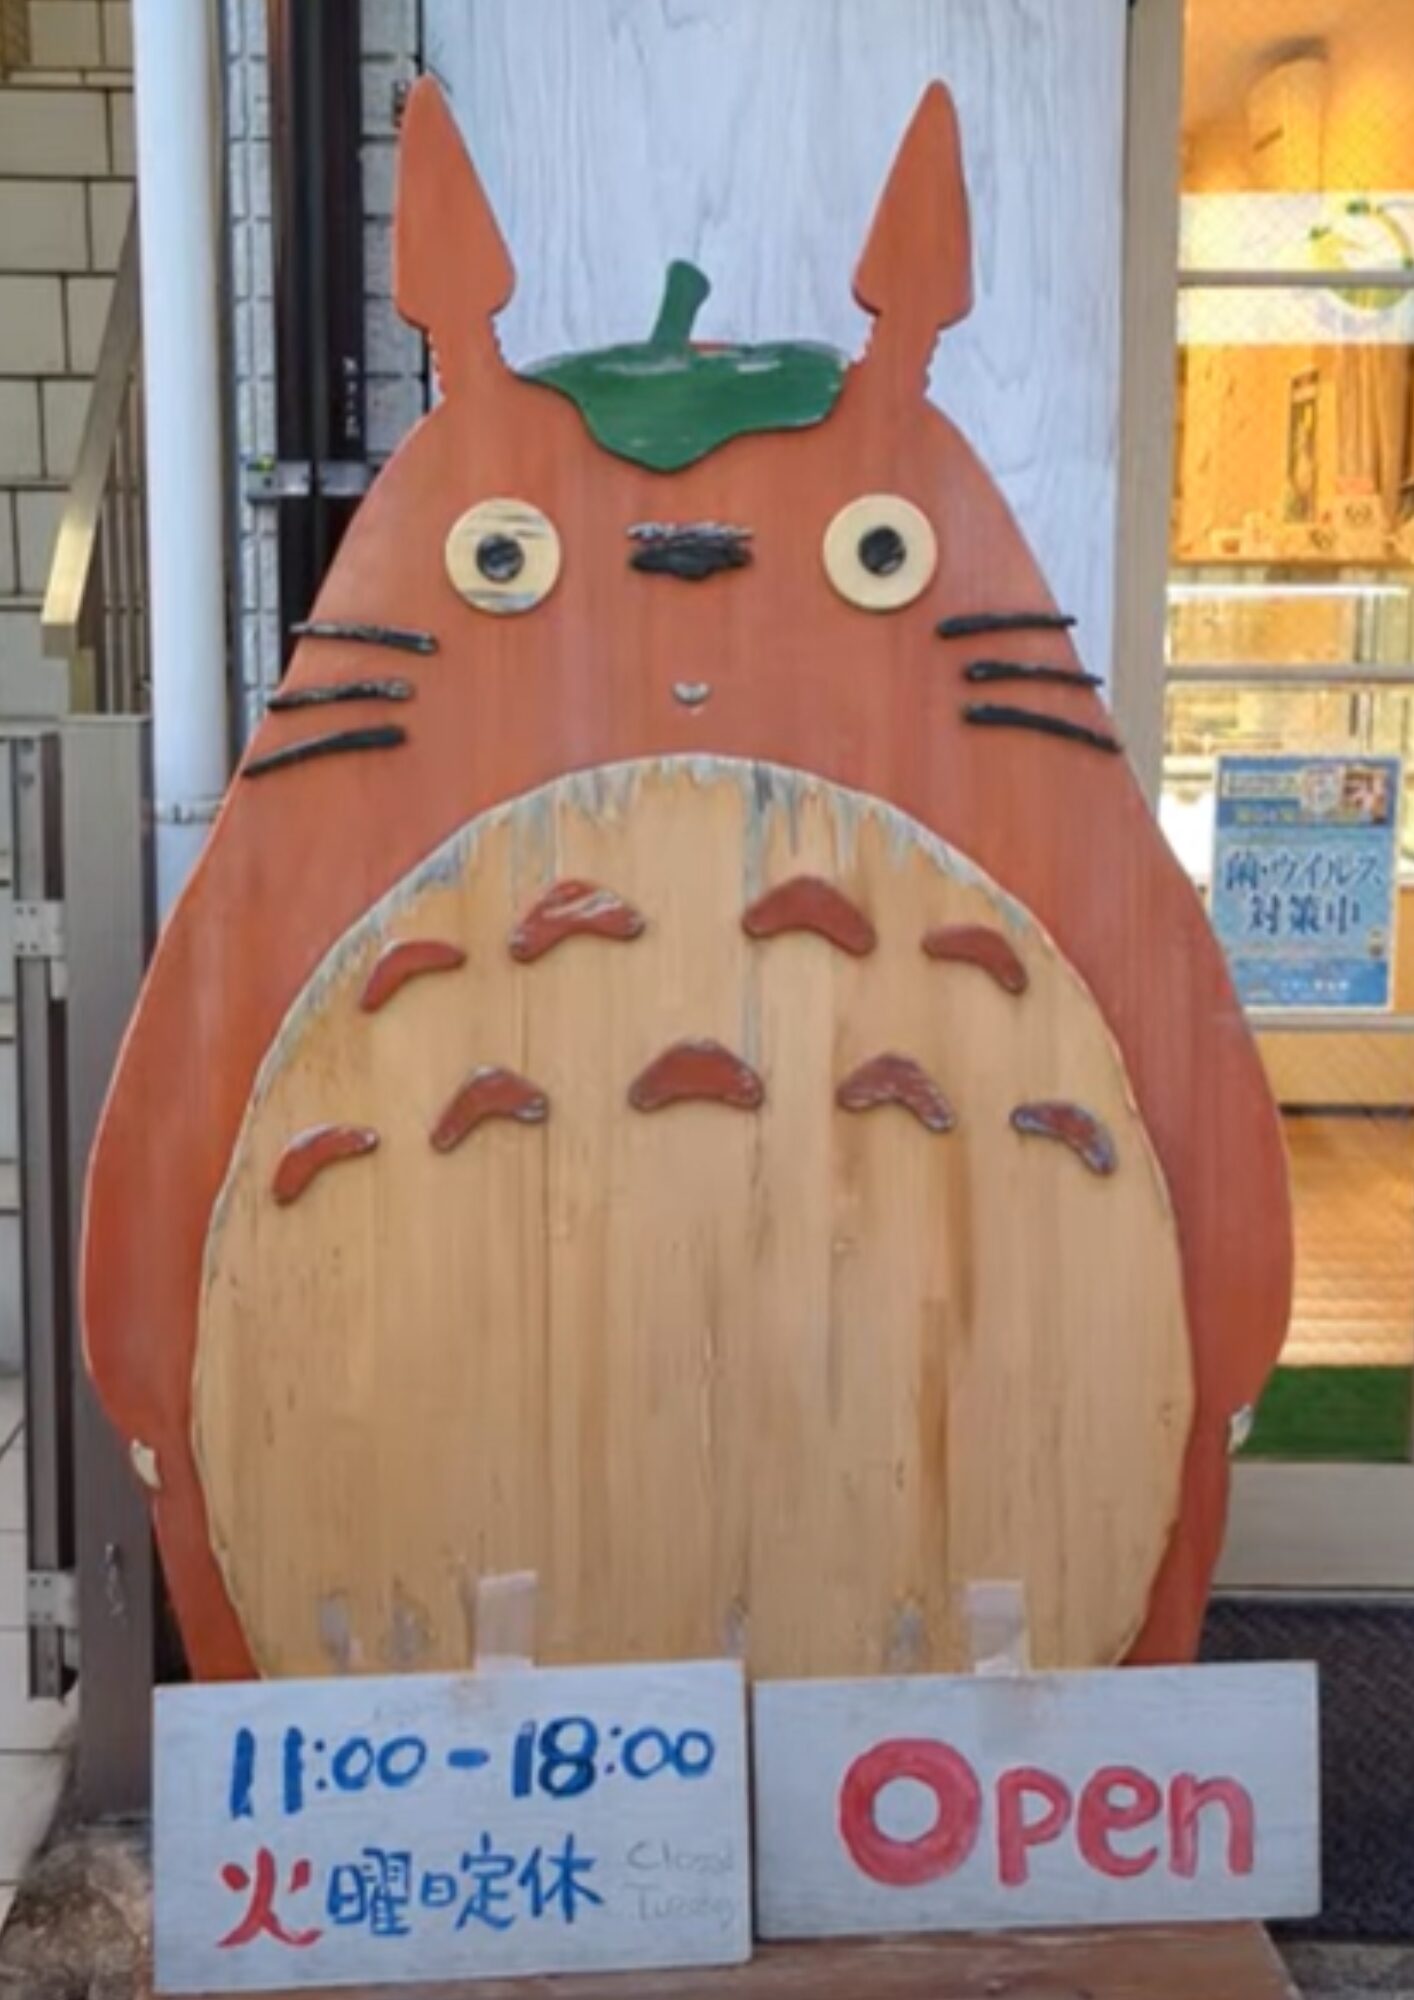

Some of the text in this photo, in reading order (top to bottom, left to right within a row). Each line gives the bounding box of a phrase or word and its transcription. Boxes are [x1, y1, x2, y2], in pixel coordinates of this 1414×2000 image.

[1249, 894, 1361, 936] 対策中
[838, 1739, 1254, 1887] Open
[217, 1831, 605, 1948] 火曜日定休
